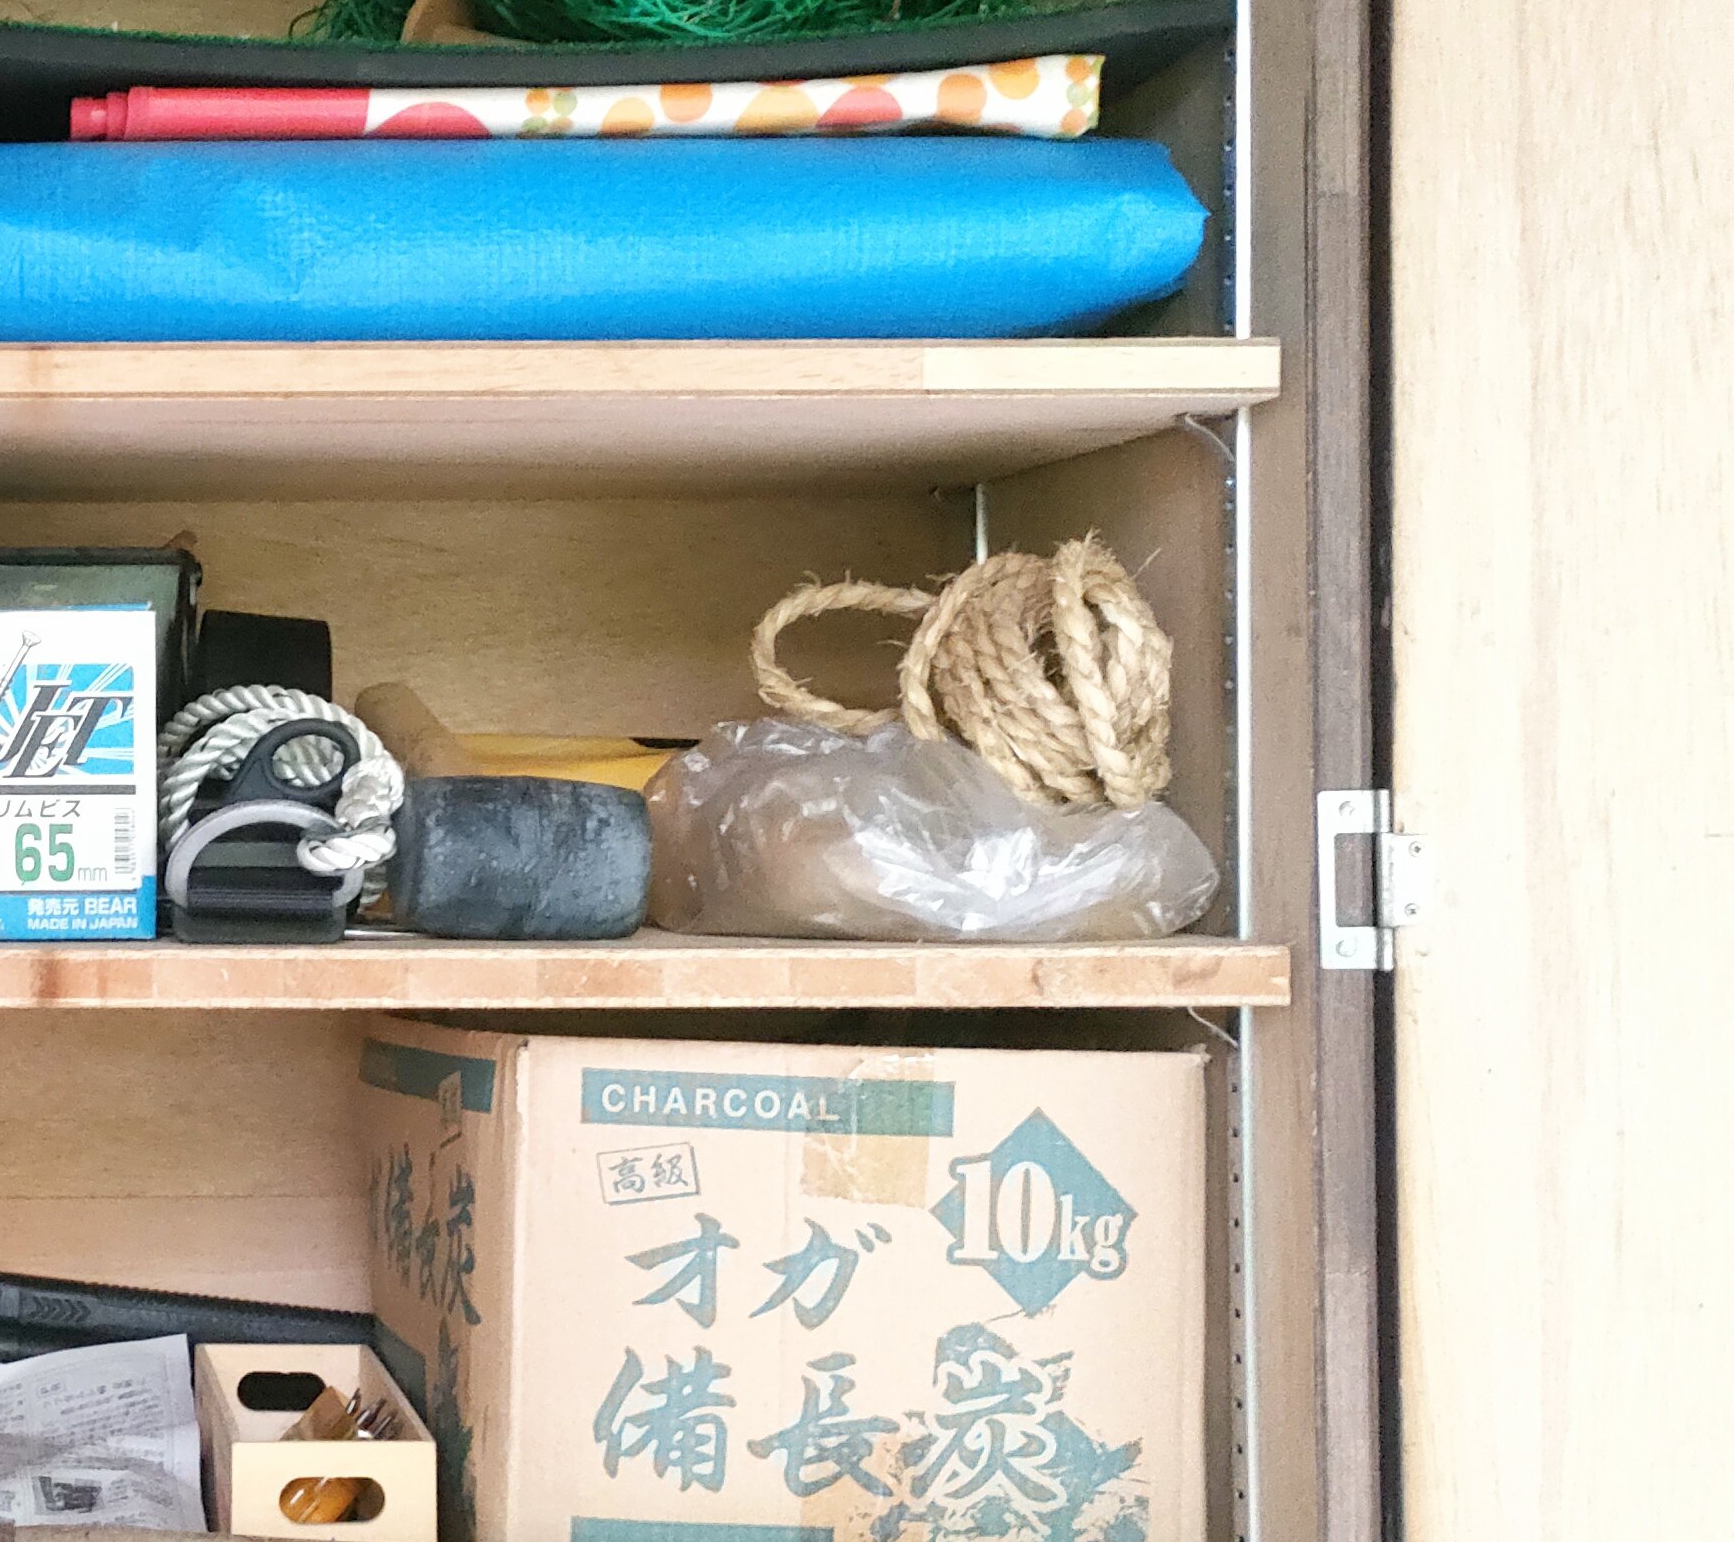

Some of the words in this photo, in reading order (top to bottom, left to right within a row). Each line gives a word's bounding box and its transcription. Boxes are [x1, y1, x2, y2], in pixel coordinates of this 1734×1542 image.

[27, 897, 79, 917] 発売元
[84, 897, 138, 916] BEAR
[27, 916, 69, 931] MADE
[71, 917, 88, 931] IN
[89, 916, 139, 931] JAPAN
[599, 1082, 843, 1124] CHARCOAL
[606, 1151, 691, 1195] 高級
[951, 1155, 1129, 1281] 10kg
[625, 1211, 894, 1331] オガ
[591, 1344, 1056, 1507] 備長炭
